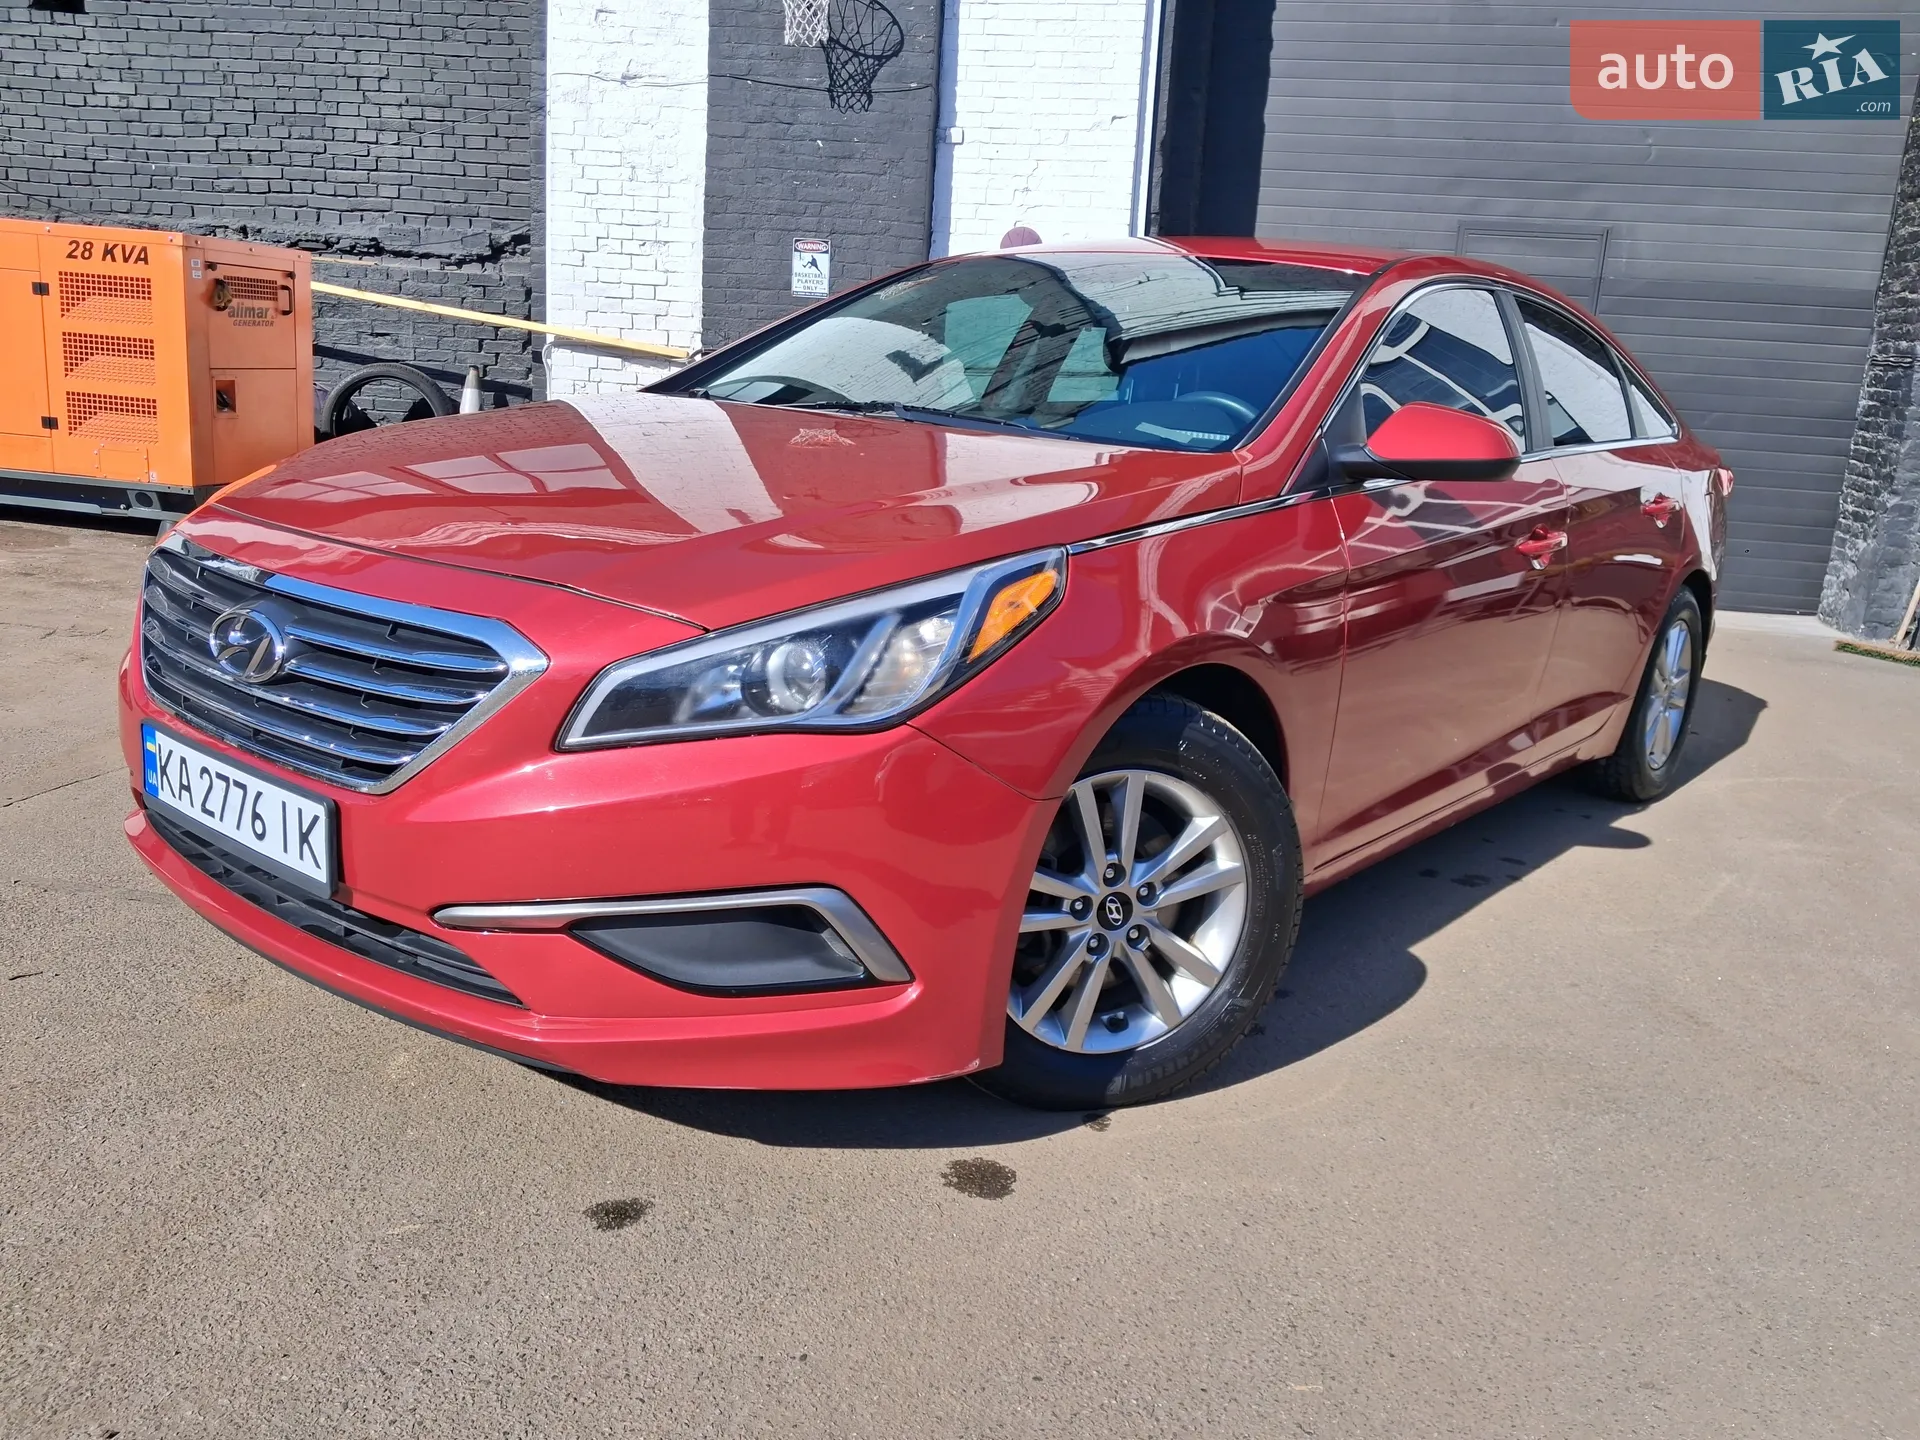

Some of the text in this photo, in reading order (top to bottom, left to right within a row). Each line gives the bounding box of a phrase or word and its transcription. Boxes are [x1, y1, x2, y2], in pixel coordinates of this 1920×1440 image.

[66, 240, 149, 265] 28 KVA
[797, 243, 827, 251] WARNING
[794, 272, 827, 280] BASKETBALL
[227, 302, 271, 319] alimar
[232, 319, 275, 327] GENERATOR
[147, 768, 158, 787] UA
[157, 743, 322, 870] KA 2776 IK
